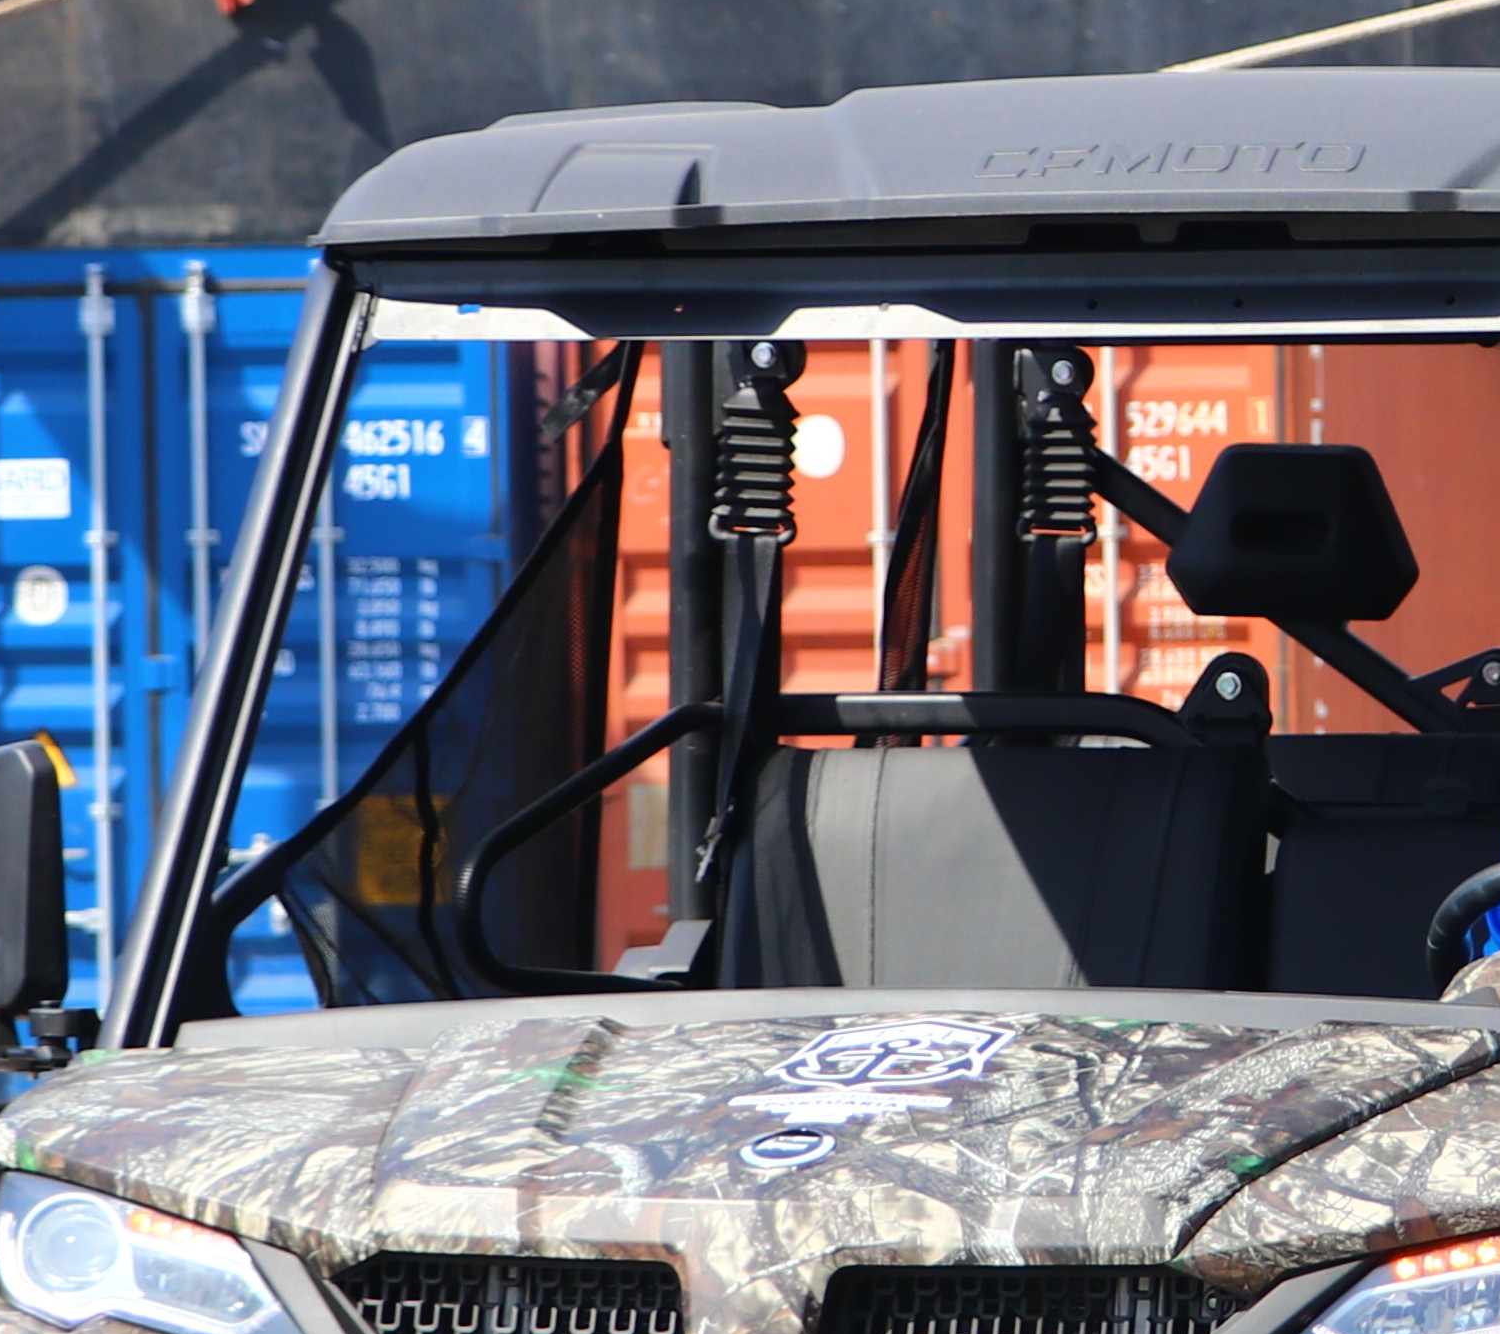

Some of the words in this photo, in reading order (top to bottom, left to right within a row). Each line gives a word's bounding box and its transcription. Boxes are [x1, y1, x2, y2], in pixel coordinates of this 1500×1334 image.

[974, 141, 1367, 179] CFMOTO
[1125, 399, 1229, 438] 529644
[1255, 399, 1270, 435] 1
[341, 419, 445, 457] 462516
[463, 419, 487, 454] 4
